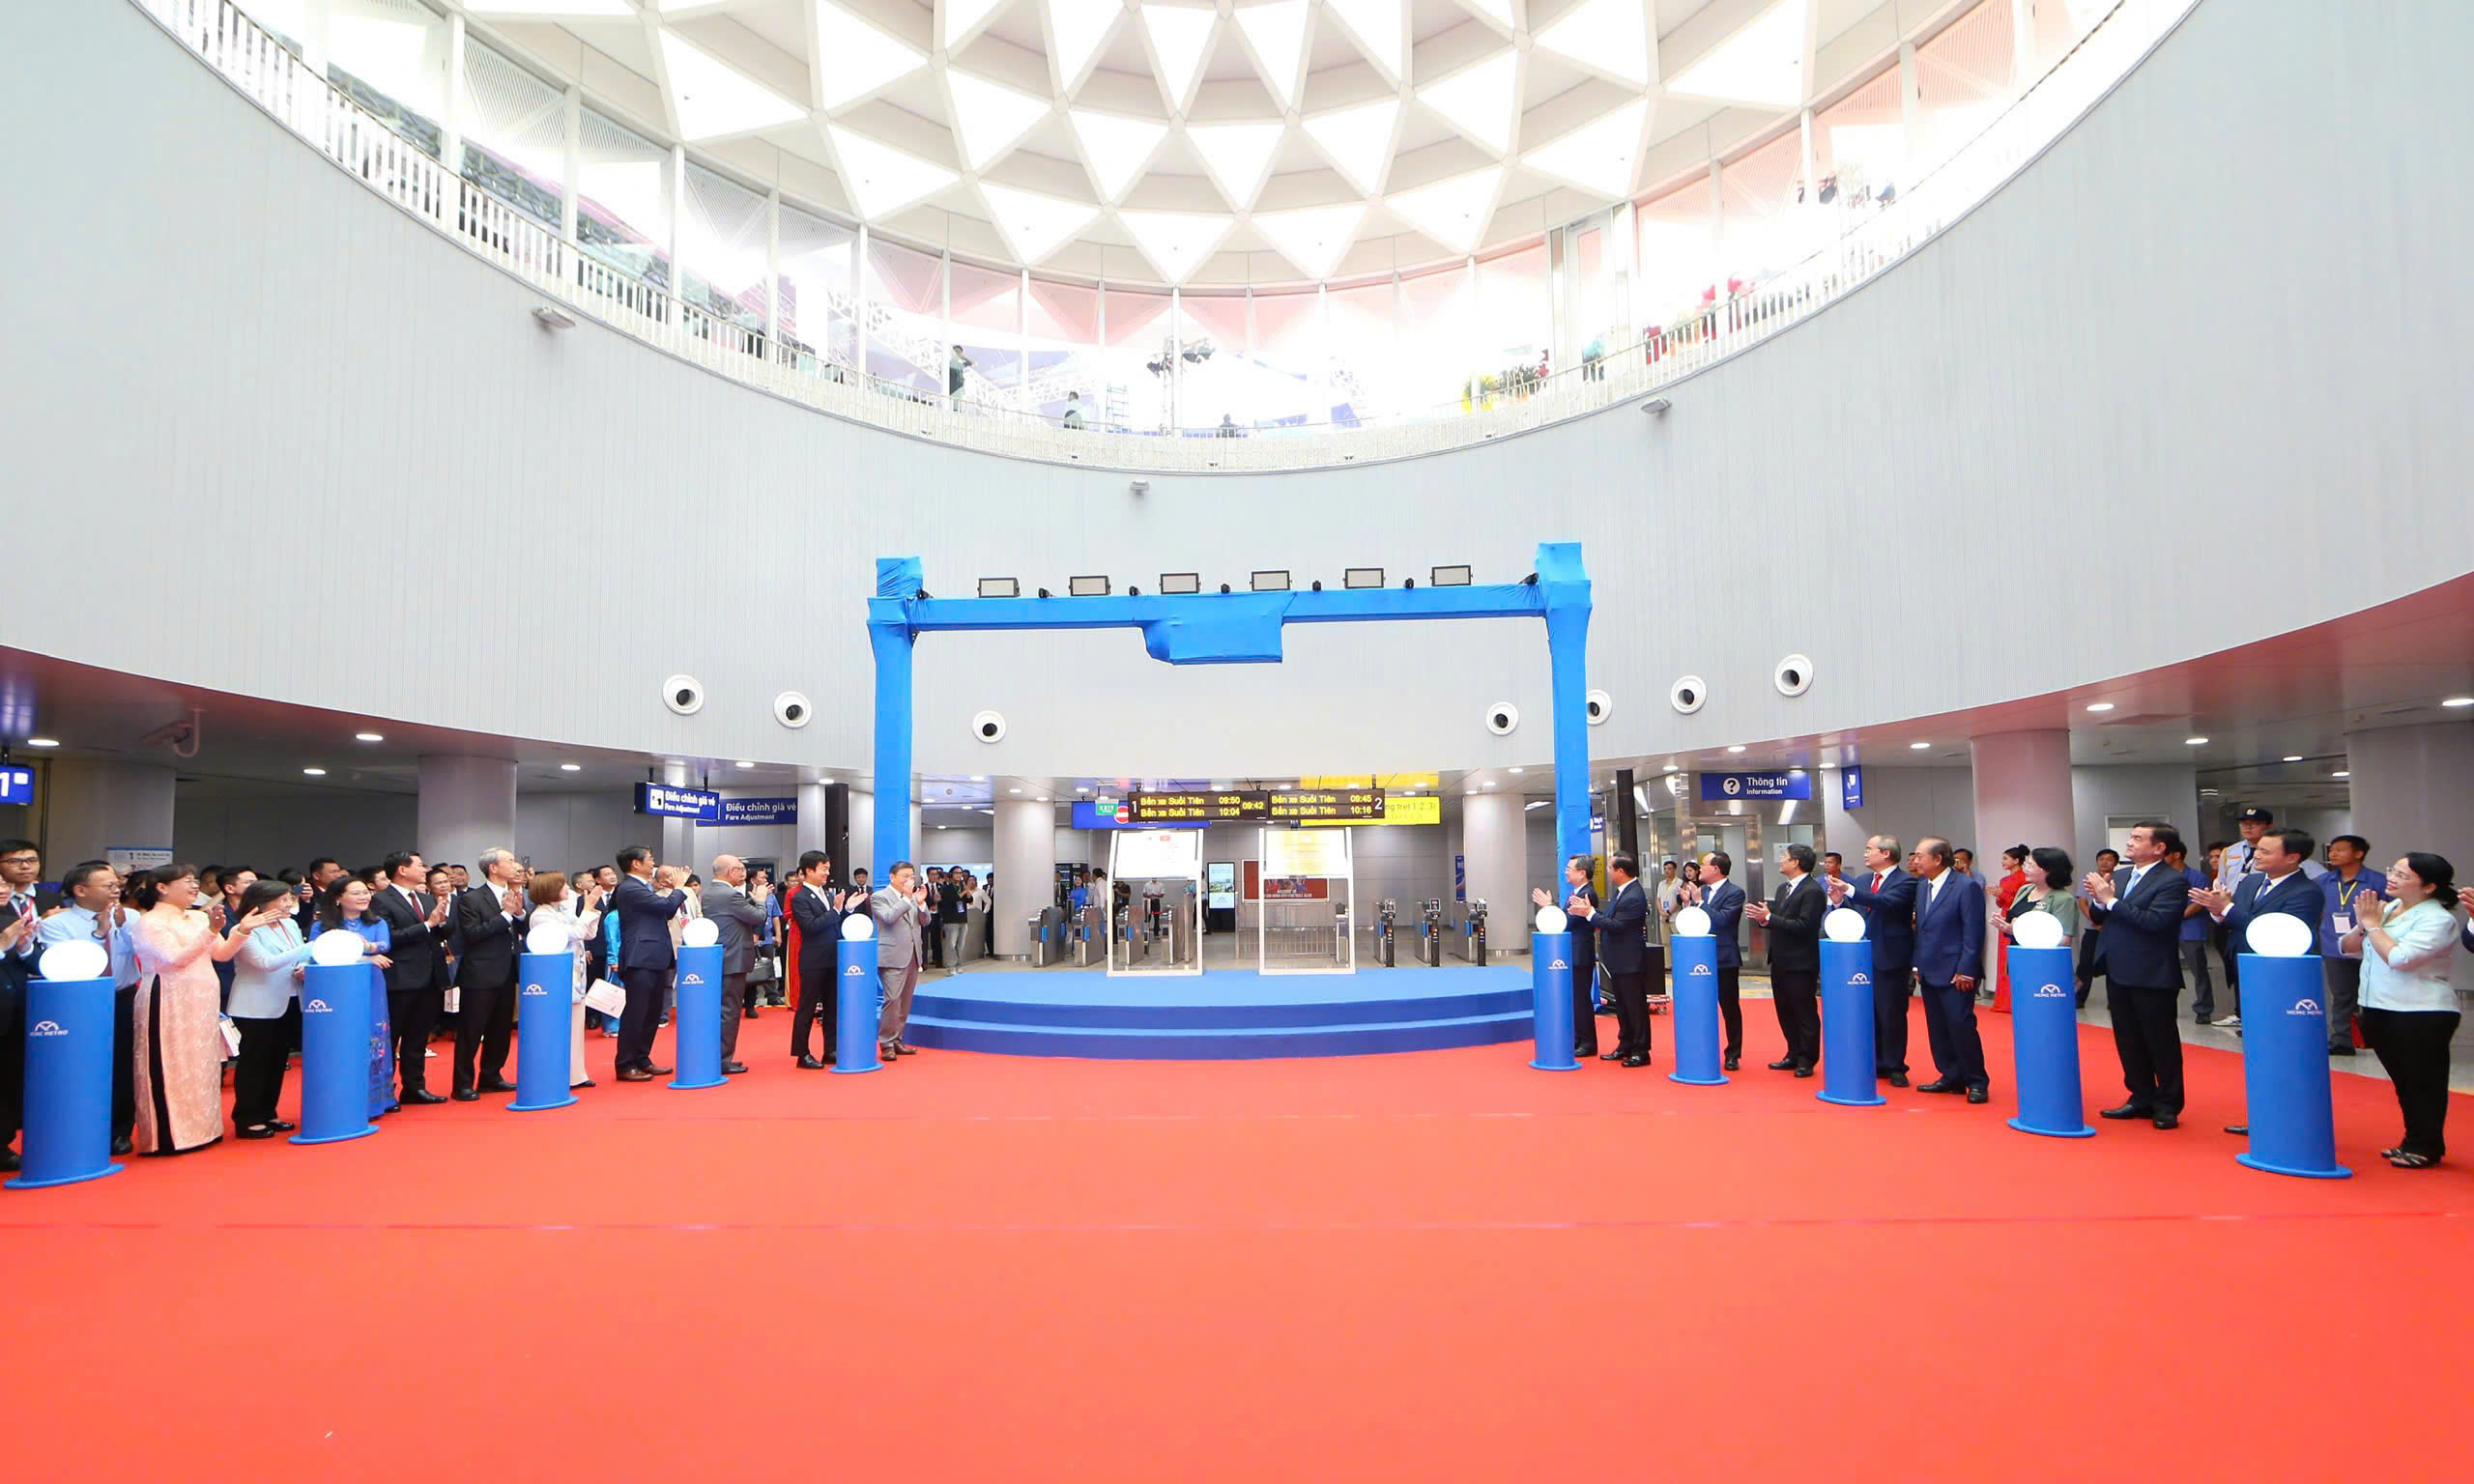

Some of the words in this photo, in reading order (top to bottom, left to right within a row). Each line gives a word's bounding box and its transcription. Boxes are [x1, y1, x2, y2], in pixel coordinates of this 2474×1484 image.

[0, 772, 10, 797] 1
[1746, 777, 1774, 787] Thông
[1776, 777, 1788, 786] tin
[1350, 794, 1372, 803] 09:45
[726, 802, 745, 812] Điều
[747, 802, 770, 812] chỉnh
[1132, 800, 1137, 813] 1
[1242, 801, 1264, 810] 09:42
[1374, 797, 1383, 811] 2
[1219, 808, 1240, 816] 10:04
[1350, 806, 1372, 814] 10:16
